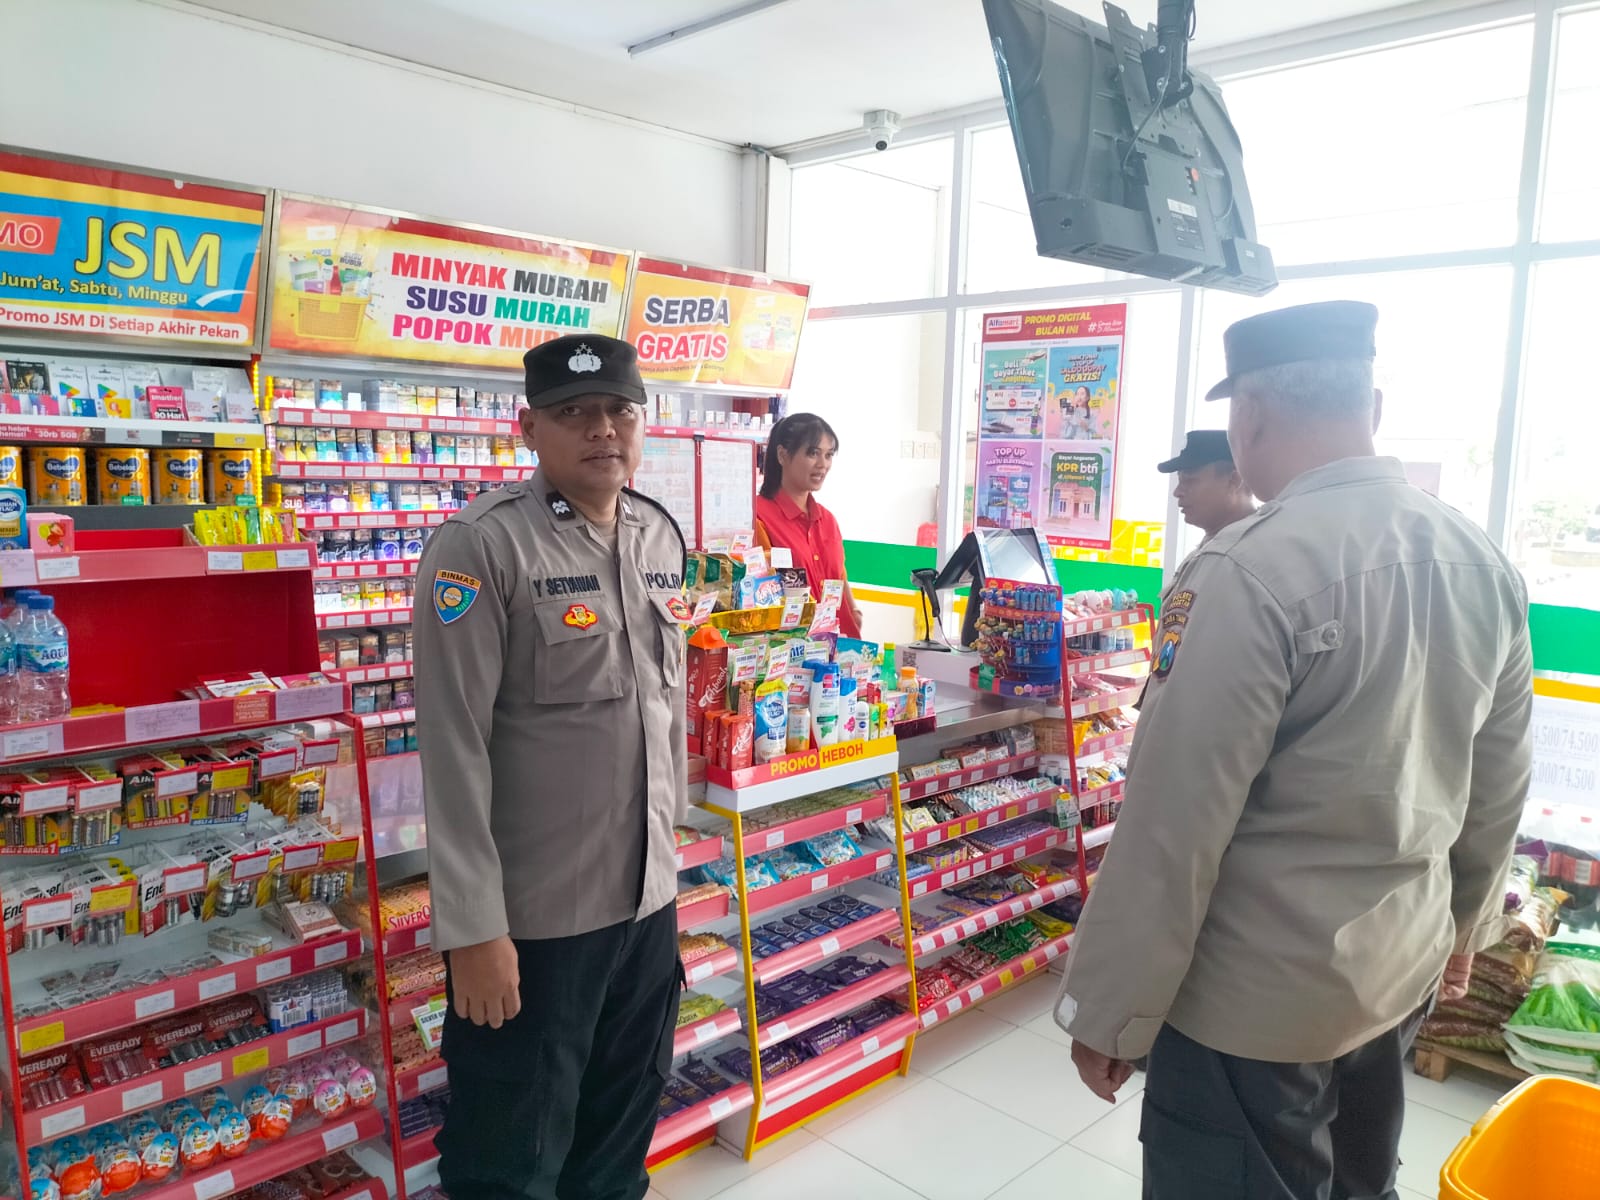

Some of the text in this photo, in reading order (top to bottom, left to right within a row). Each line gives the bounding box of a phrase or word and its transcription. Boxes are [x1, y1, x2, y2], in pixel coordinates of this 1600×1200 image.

[74, 216, 221, 287] JSM
[391, 252, 609, 303] MINYAK MURAH
[69, 279, 123, 299] Sabtu,
[128, 285, 188, 304] Minggu
[406, 285, 591, 328] SUSU MURAH
[645, 297, 729, 325] SERBA
[53, 312, 85, 326] JSM
[89, 315, 105, 328] Di
[109, 317, 154, 335] Setiap
[158, 324, 196, 336] Akhir
[200, 325, 240, 340] Pekan
[988, 312, 1091, 328] Alfamart PROMO DIGITAL
[1035, 325, 1078, 336] BULAN INI
[392, 314, 578, 350] POPOK MUR
[638, 333, 728, 361] GRATIS
[154, 411, 165, 419] 90
[995, 448, 1026, 457] TOP UP
[1056, 463, 1079, 473] KPR
[441, 571, 475, 585] BINMAS
[533, 580, 542, 597] Y
[42, 649, 67, 660] AQUA
[770, 743, 863, 776] PROMO HEBOH
[179, 812, 187, 823] 1
[238, 812, 248, 822] 2
[49, 842, 57, 853] 1
[209, 1007, 254, 1027] EVEREADY
[154, 1022, 203, 1045] EVEREADY
[90, 1036, 141, 1058] EVEREADY
[18, 1053, 68, 1076] VEREADY
